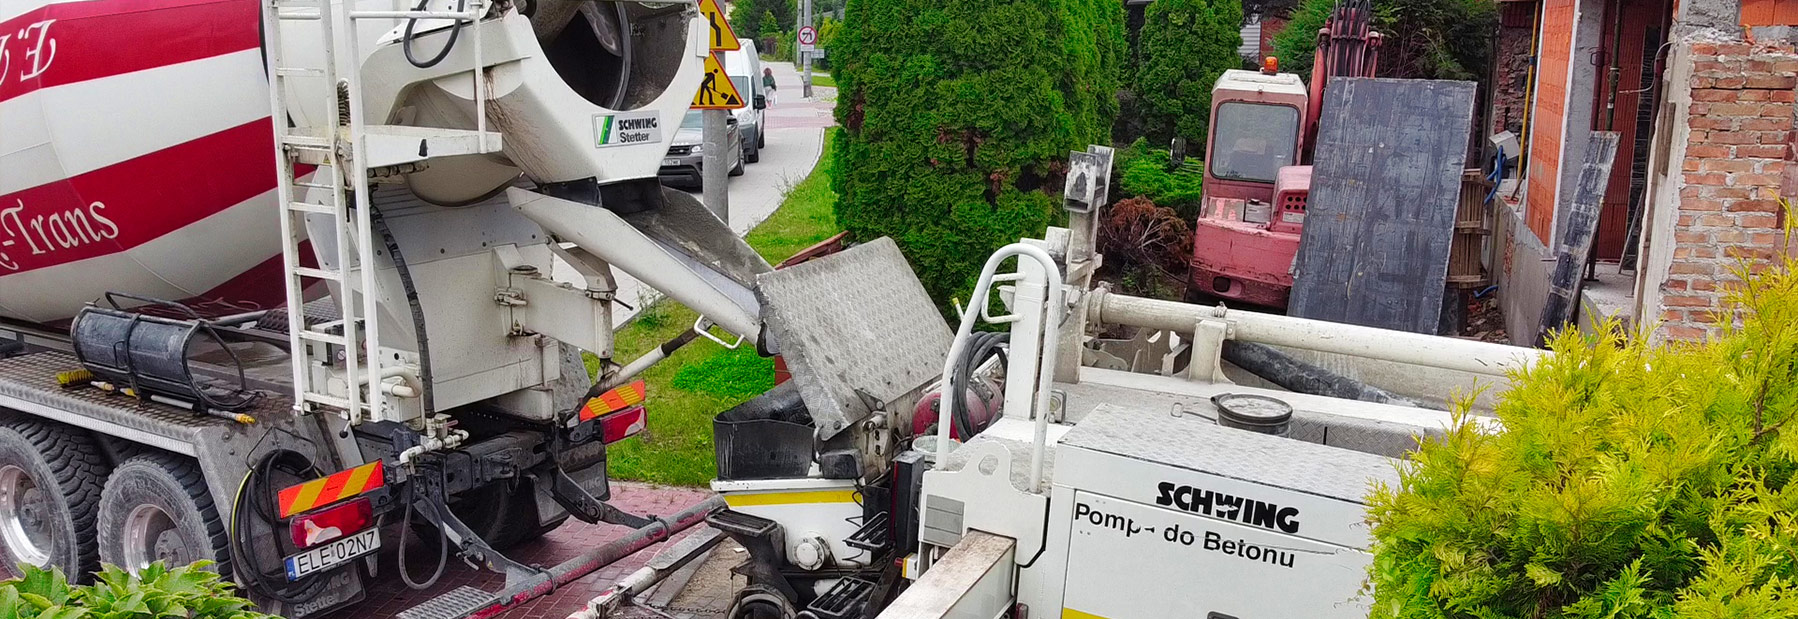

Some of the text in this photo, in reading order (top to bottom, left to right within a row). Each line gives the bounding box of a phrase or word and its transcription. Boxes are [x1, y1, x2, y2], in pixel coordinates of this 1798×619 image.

[618, 117, 658, 131] SCHWING
[620, 131, 650, 143] Stetter
[1156, 481, 1299, 534] SCHWING
[298, 546, 331, 575] ELE
[336, 531, 375, 559] 02N7
[1075, 502, 1295, 568] Pomp do Betonu
